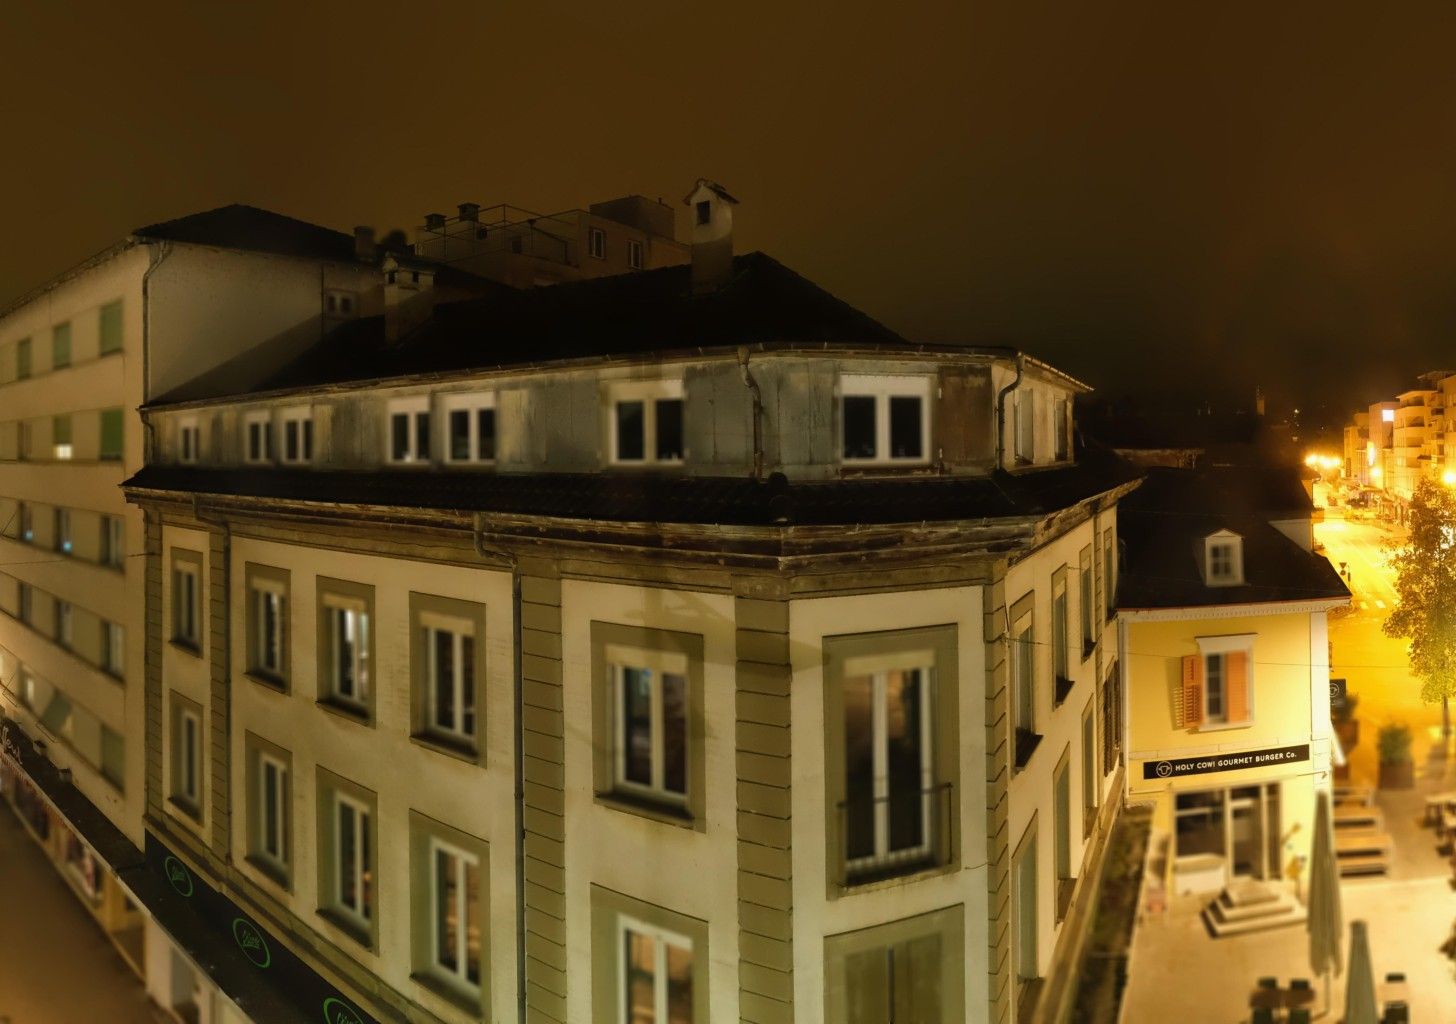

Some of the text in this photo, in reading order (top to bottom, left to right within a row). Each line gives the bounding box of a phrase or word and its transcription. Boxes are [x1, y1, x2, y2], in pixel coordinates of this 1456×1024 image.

[1175, 751, 1297, 772] HOLY COW! GOURMET BURGER Co.
